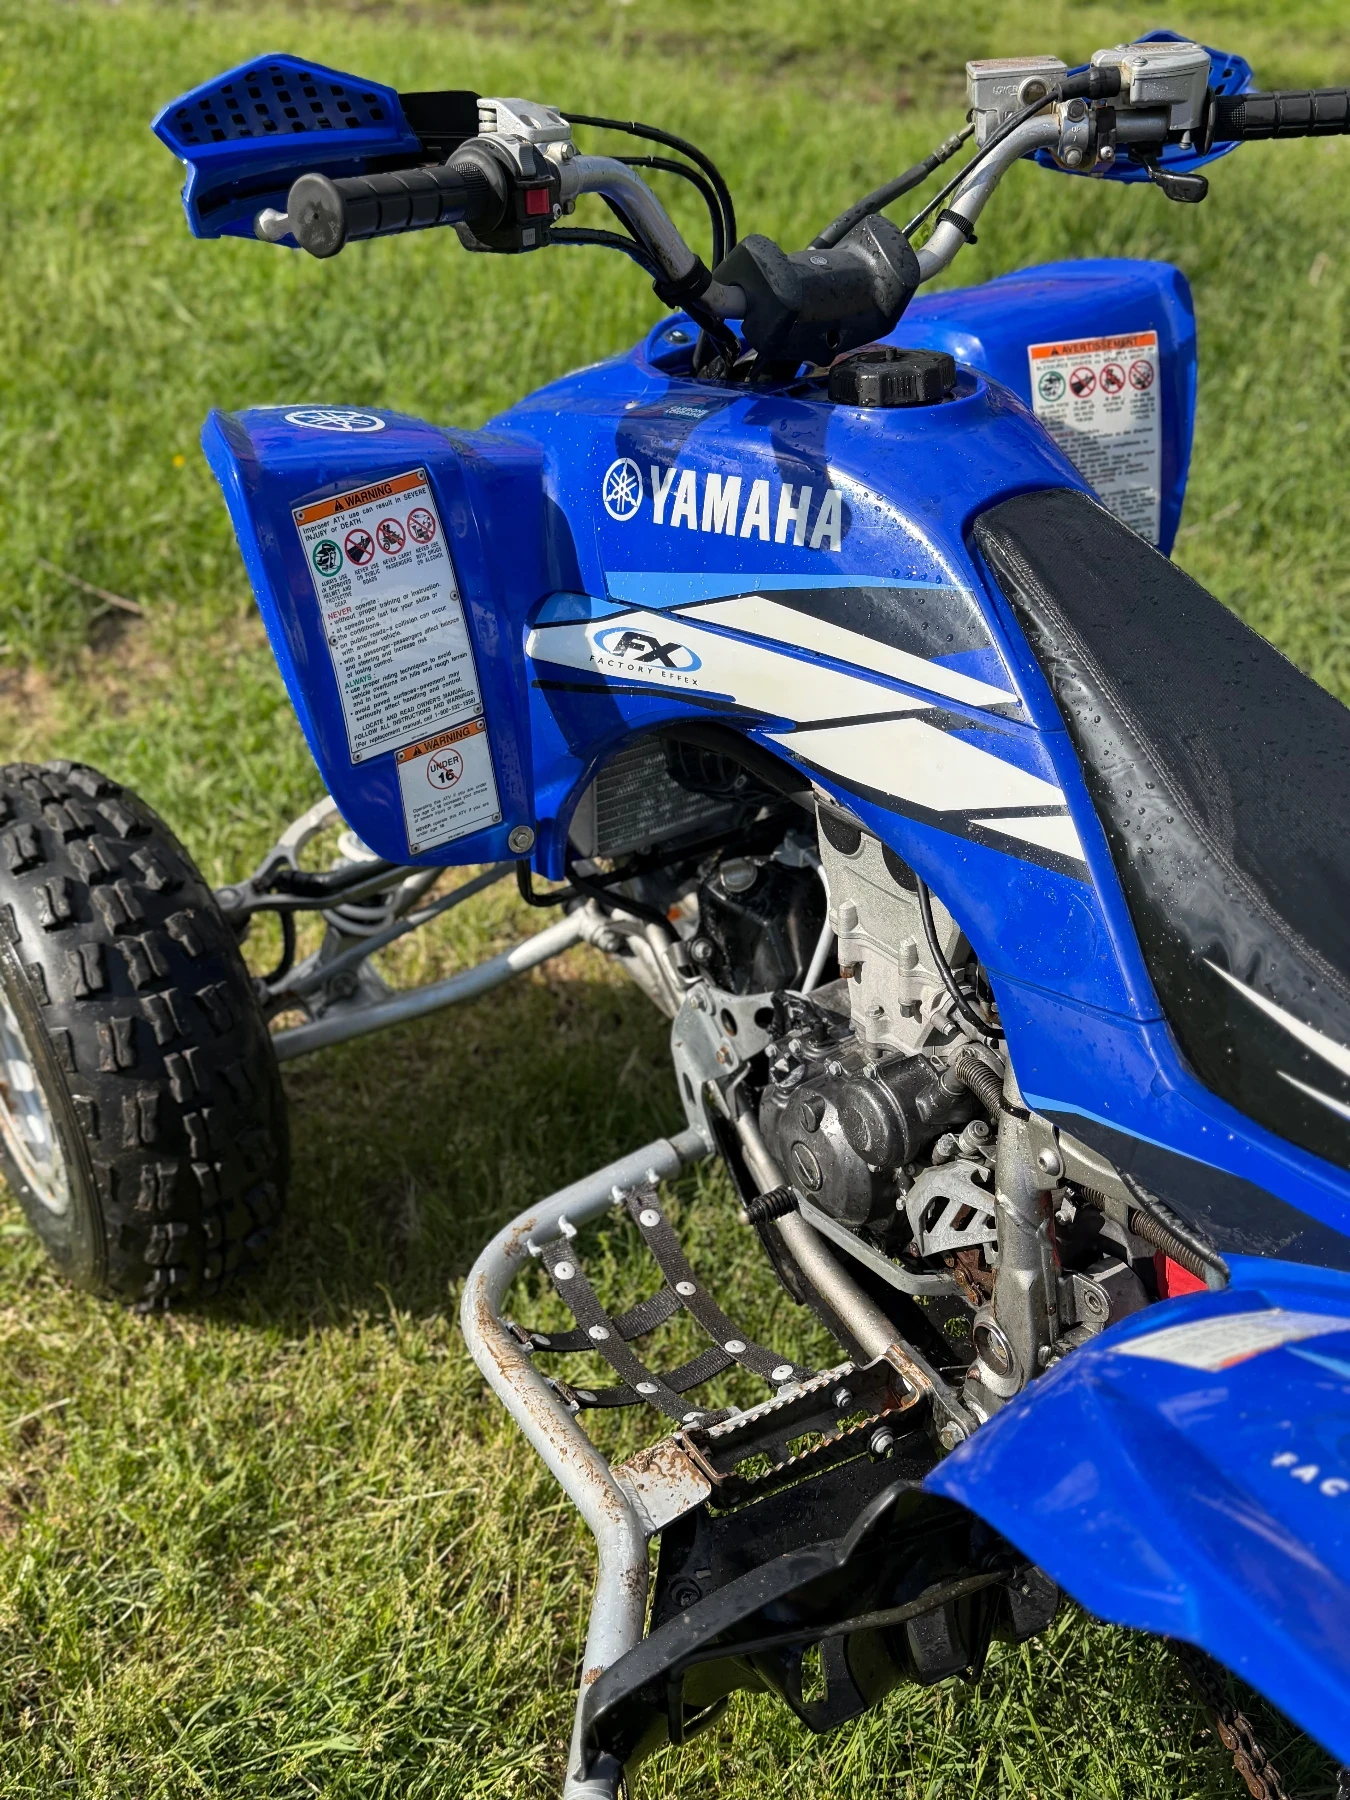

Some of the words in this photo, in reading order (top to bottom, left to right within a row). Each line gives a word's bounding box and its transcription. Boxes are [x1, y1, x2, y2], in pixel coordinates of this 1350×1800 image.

[1062, 338, 1138, 354] AVERTISSEMENT
[333, 515, 345, 524] ATV
[349, 511, 359, 519] use
[376, 499, 393, 509] result
[404, 488, 426, 500] SEVERE
[344, 483, 393, 507] WARNING
[650, 465, 843, 553] YAMAHA
[305, 529, 327, 542] INJURY
[340, 518, 363, 530] DEATH.
[398, 551, 411, 560] CARRY
[328, 606, 352, 620] NEVER
[334, 613, 356, 624] without
[359, 606, 377, 617] proper
[379, 597, 401, 608] training
[344, 619, 365, 631] speeds
[378, 610, 388, 618] fast
[401, 601, 413, 611] your
[416, 596, 430, 604] skills
[350, 635, 368, 646] public
[395, 616, 418, 629] collision
[425, 624, 439, 634] affect
[342, 648, 354, 656] with
[357, 639, 378, 650] another
[358, 655, 379, 667] steering
[382, 650, 391, 658] and
[394, 641, 415, 653] increase
[613, 631, 683, 669] FX
[352, 690, 370, 700] vehicle
[373, 679, 398, 692] overturns
[423, 665, 432, 673] and
[435, 659, 449, 668] rough
[451, 652, 467, 661] terrain
[355, 665, 372, 675] losing
[363, 679, 380, 690] proper
[382, 672, 398, 681] riding
[400, 660, 428, 675] techniques
[438, 650, 451, 660] avoid
[589, 655, 654, 676] FACTORY
[661, 670, 699, 687] EFFEX
[353, 699, 363, 707] and
[355, 705, 370, 715] avoid
[373, 697, 390, 709] paved
[448, 671, 459, 679] may
[356, 708, 381, 722] seriously
[385, 701, 400, 711] affect
[403, 691, 426, 703] handling
[429, 685, 439, 693] and
[354, 727, 377, 741] FOLLOW
[380, 723, 390, 731] ALL
[393, 706, 431, 726] INSTRUCTIONS
[434, 701, 444, 710] AND
[362, 718, 383, 731] LOCATE
[386, 713, 397, 721] AND
[400, 706, 414, 716] READ
[417, 696, 441, 709] OWNER'S
[369, 728, 400, 743] replacement
[423, 727, 471, 751] WARNING
[430, 756, 459, 773] UNDER
[438, 769, 455, 783] 16
